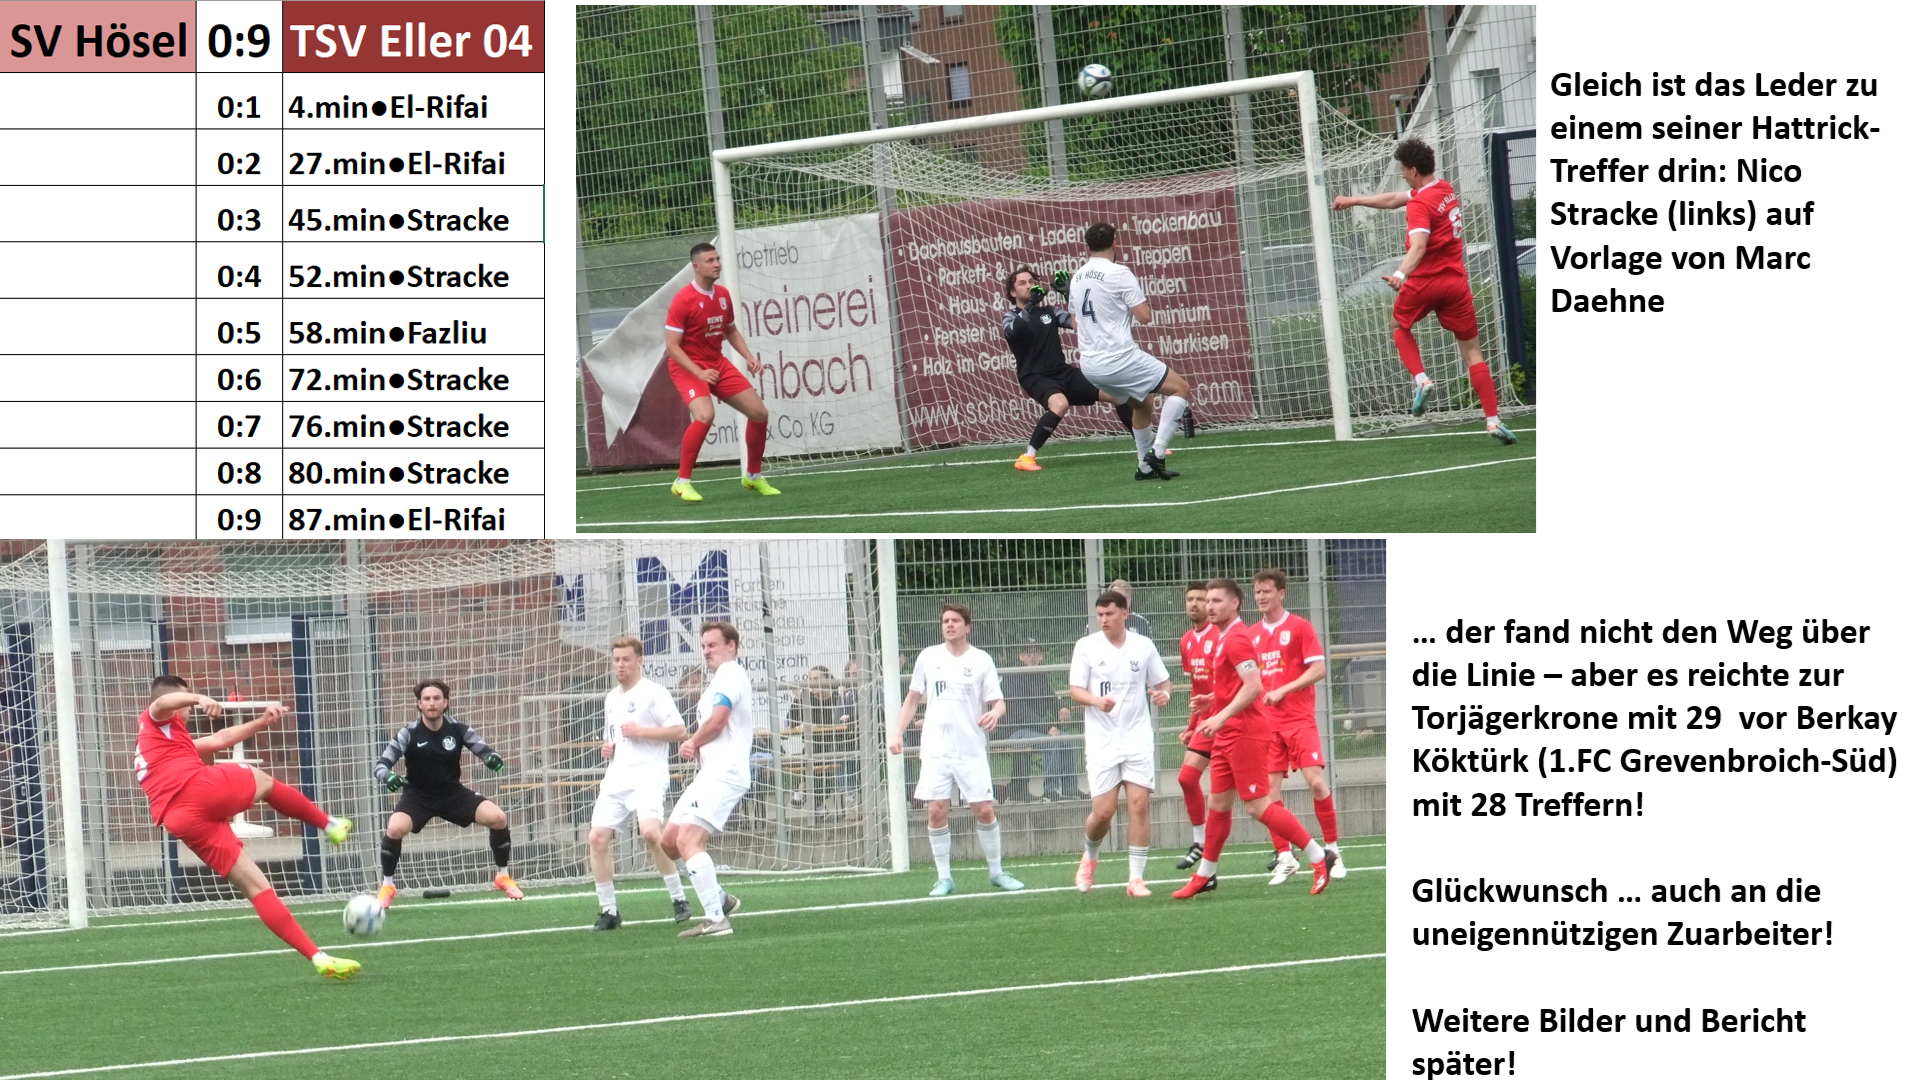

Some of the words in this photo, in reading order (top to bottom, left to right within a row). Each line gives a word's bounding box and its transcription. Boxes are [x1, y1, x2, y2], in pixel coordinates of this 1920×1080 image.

[1437, 201, 1447, 214] TSV
[908, 232, 1022, 260] Dachausbauten
[1132, 211, 1222, 236] Trockenbau
[939, 263, 992, 287] Parkett-
[1133, 245, 1192, 269] Treppen
[1085, 269, 1105, 281] HÖSEL
[1082, 288, 1097, 323] 4
[707, 315, 724, 325] REWE
[934, 326, 985, 347] Fenster
[923, 356, 953, 377] Holz
[1160, 333, 1229, 356] Markisen
[689, 389, 696, 398] 9
[810, 410, 834, 437] KG
